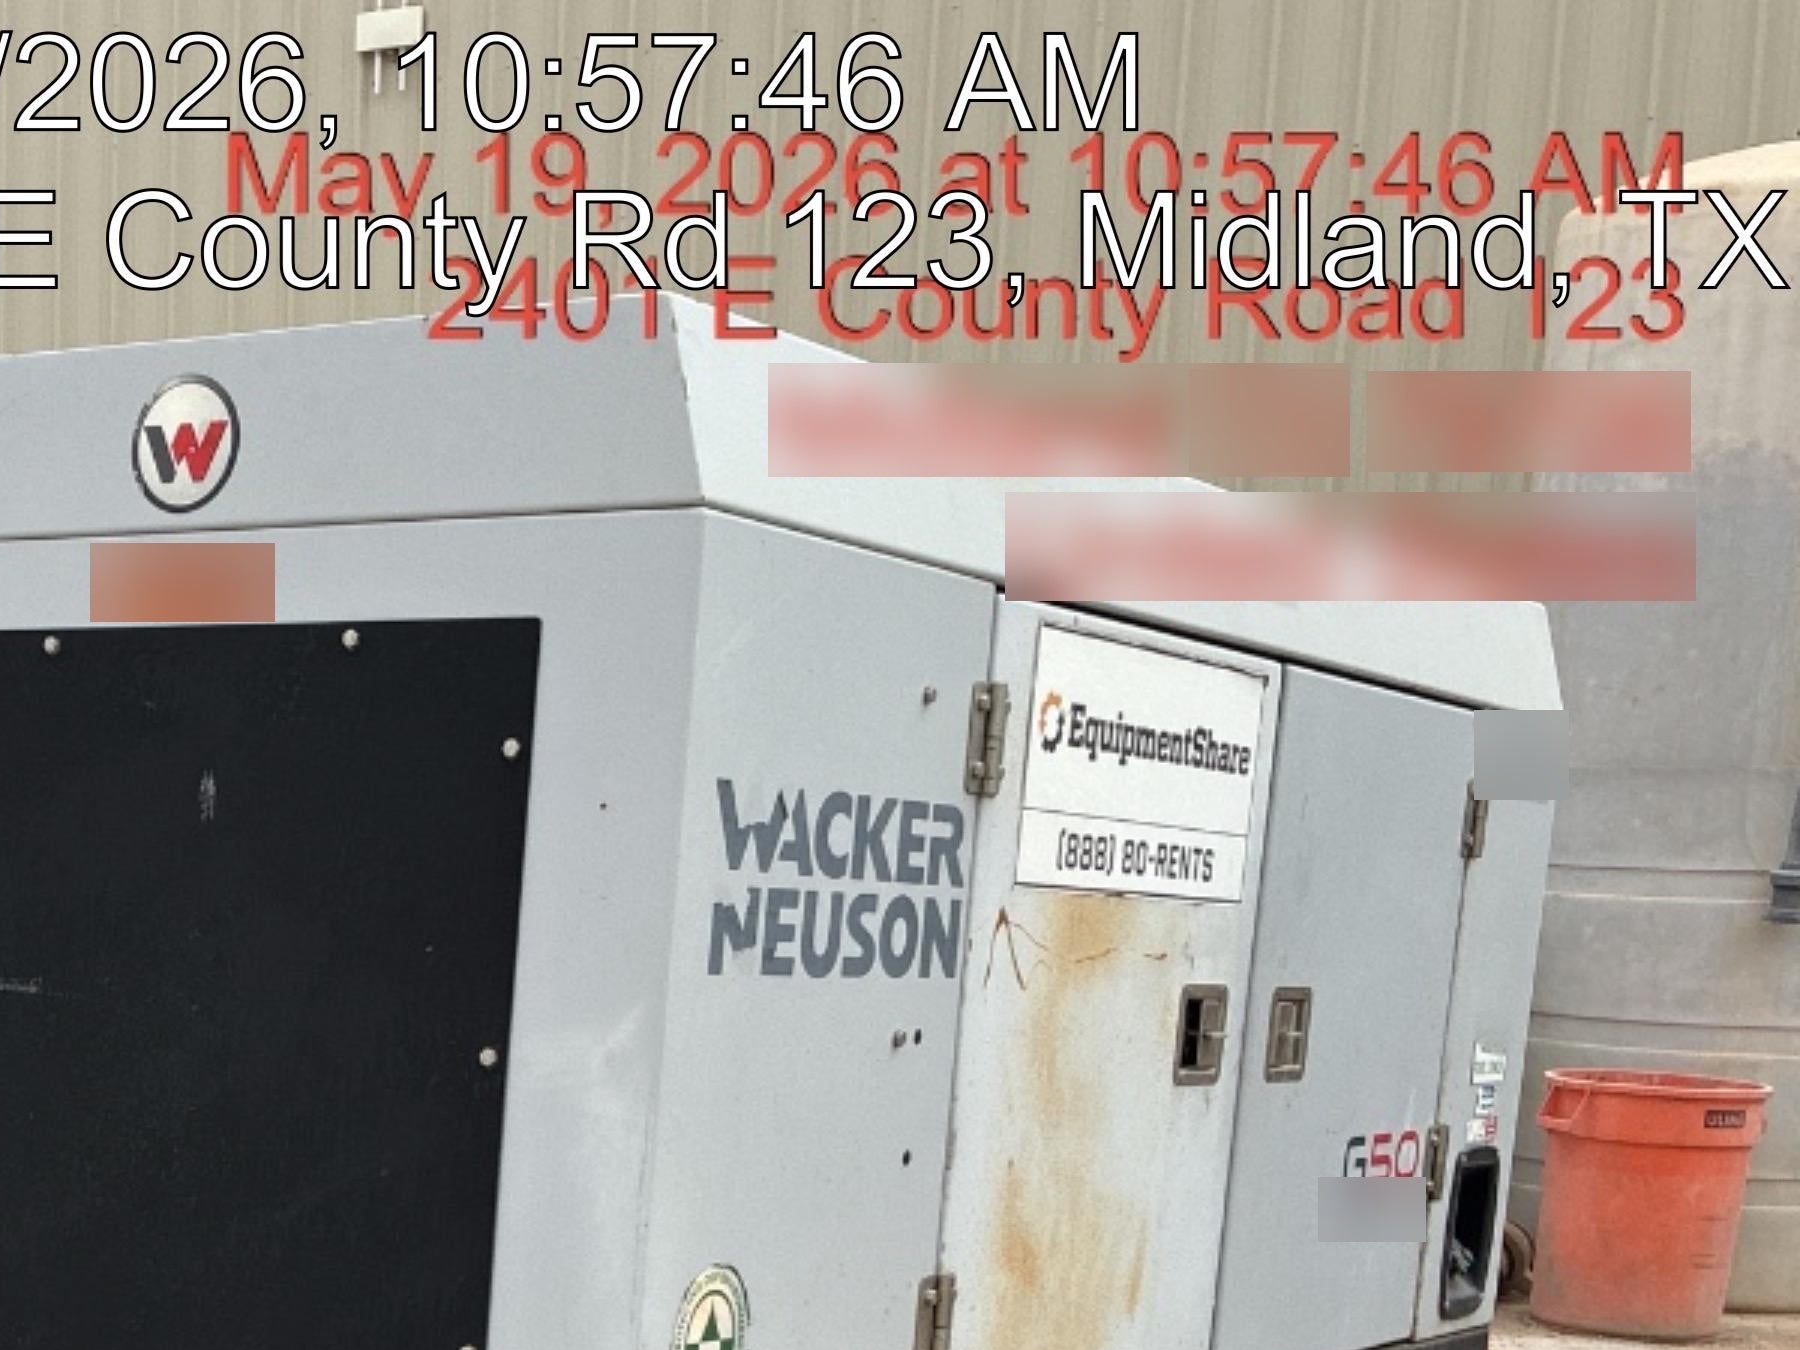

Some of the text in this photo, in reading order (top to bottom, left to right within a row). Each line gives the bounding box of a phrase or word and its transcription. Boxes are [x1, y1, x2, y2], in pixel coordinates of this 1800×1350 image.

[1067, 702, 1251, 776] EquipmentShare
[716, 776, 964, 888] WACKER
[1056, 827, 1215, 884] (888) 80-RENTS
[707, 886, 963, 979] NEUSON
[1343, 1129, 1421, 1178] G50
